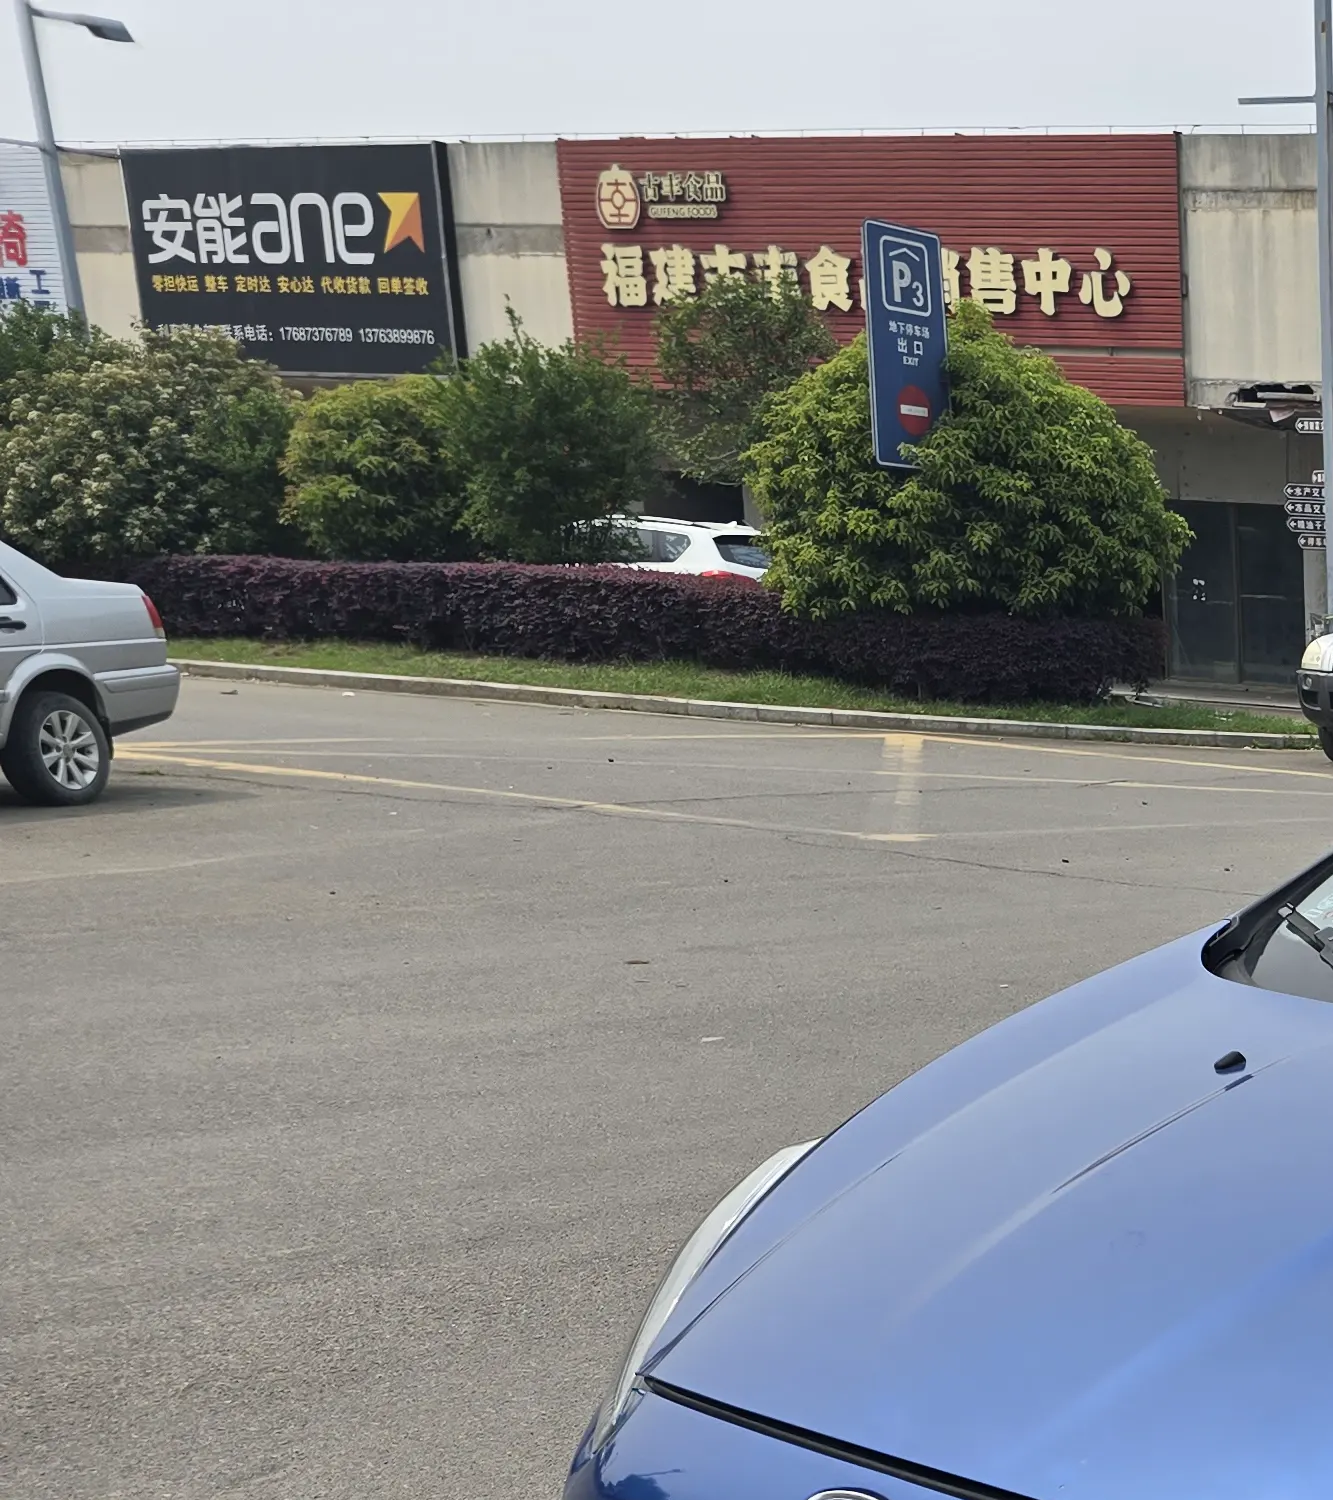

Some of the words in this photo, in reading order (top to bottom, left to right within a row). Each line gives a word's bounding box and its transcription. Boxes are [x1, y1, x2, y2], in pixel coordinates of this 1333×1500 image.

[639, 171, 727, 202] 古丰食品
[649, 206, 685, 217] GUFENG
[687, 206, 717, 218] FOODS
[152, 275, 199, 293] 零担快运
[204, 275, 229, 293] 整车
[234, 276, 272, 293] 定时达
[277, 276, 315, 294] 安心达
[320, 277, 371, 295] 代收货款
[377, 277, 429, 296] 回单签收
[600, 243, 1131, 318] 福建古丰食售中心
[279, 327, 353, 342] 17687376789
[358, 328, 435, 345] 13763899876
[889, 320, 930, 340] 地下停车场
[898, 337, 924, 355] 出口
[903, 356, 919, 367] EXIT
